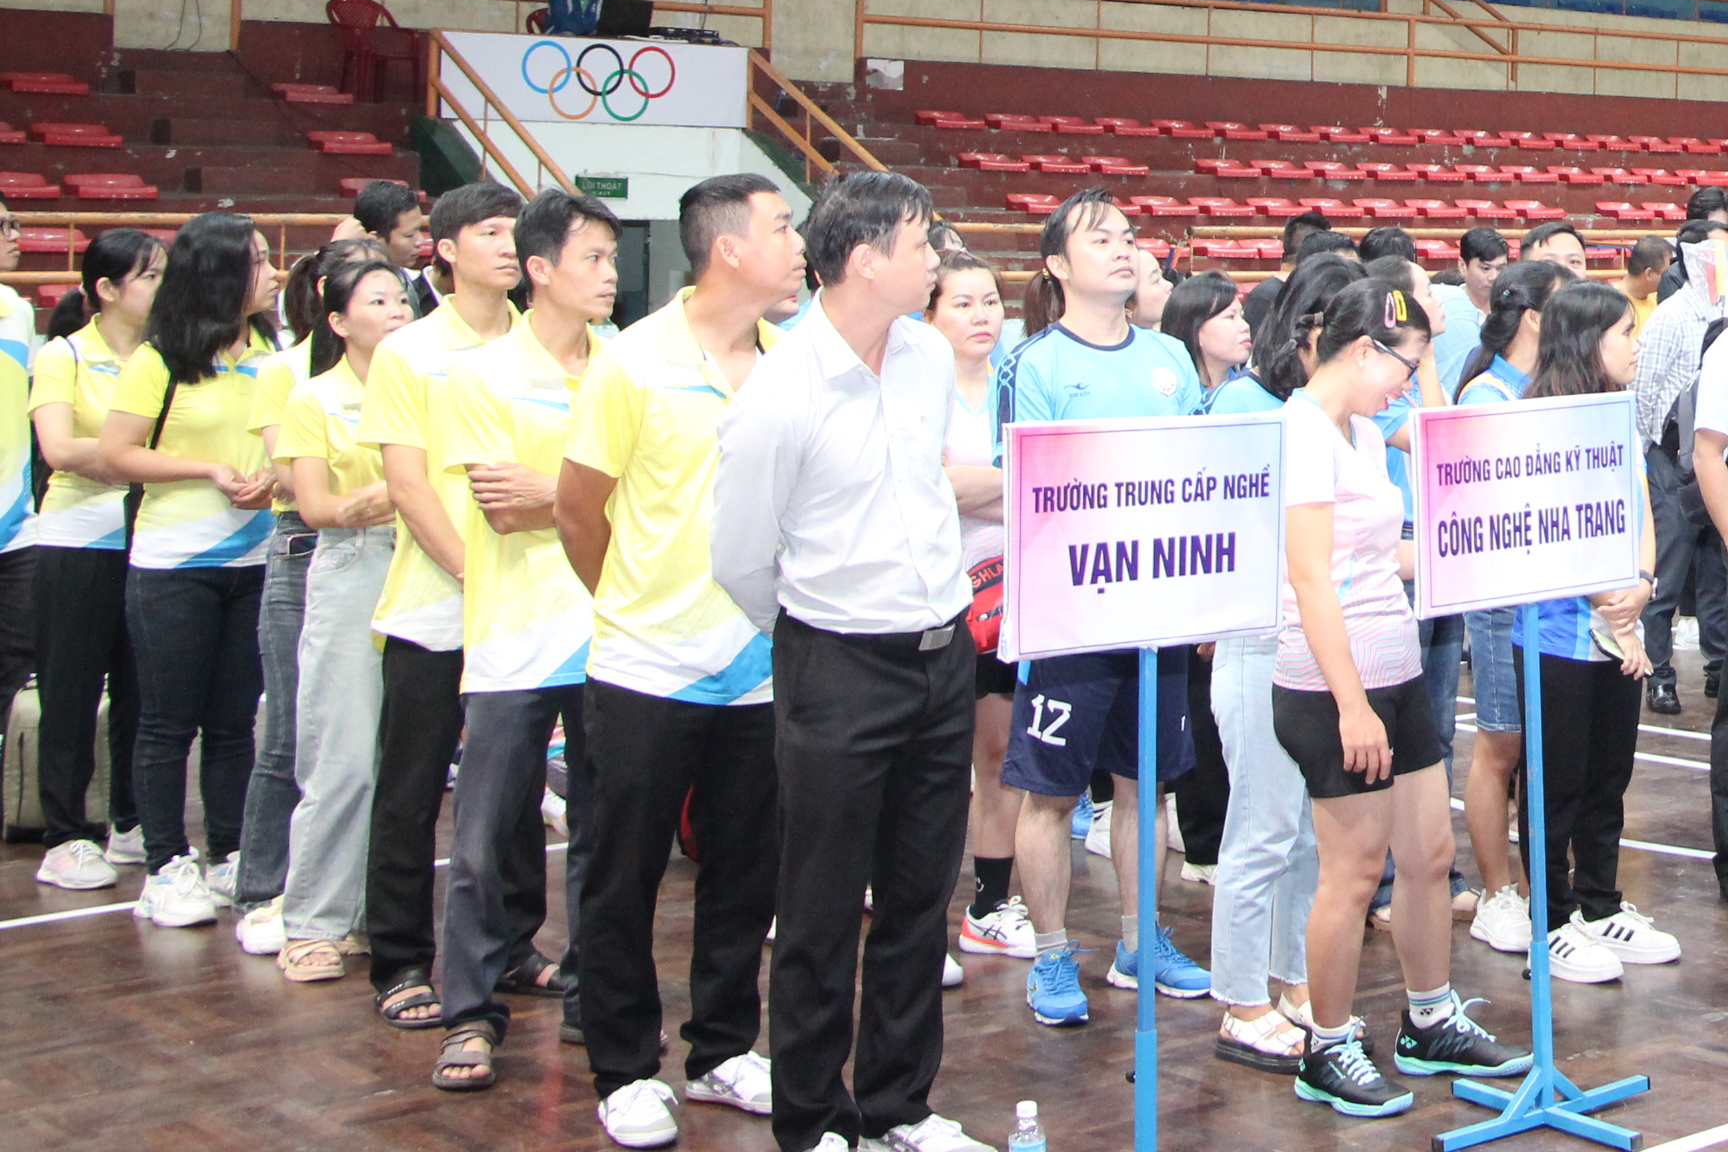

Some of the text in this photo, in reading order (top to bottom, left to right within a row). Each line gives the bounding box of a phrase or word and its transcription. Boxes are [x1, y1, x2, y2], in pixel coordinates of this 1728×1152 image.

[1033, 463, 1270, 513] TRƯỜNG TRUNG CẤP NGHỀ
[1437, 440, 1624, 486] TRƯỜNG CAO ĐẲNG KỸ THUẬT
[1437, 498, 1626, 558] CÔNG NGHỆ NHA TRANG
[1068, 532, 1236, 594] VẠN NINH
[1027, 694, 1072, 746] 12
